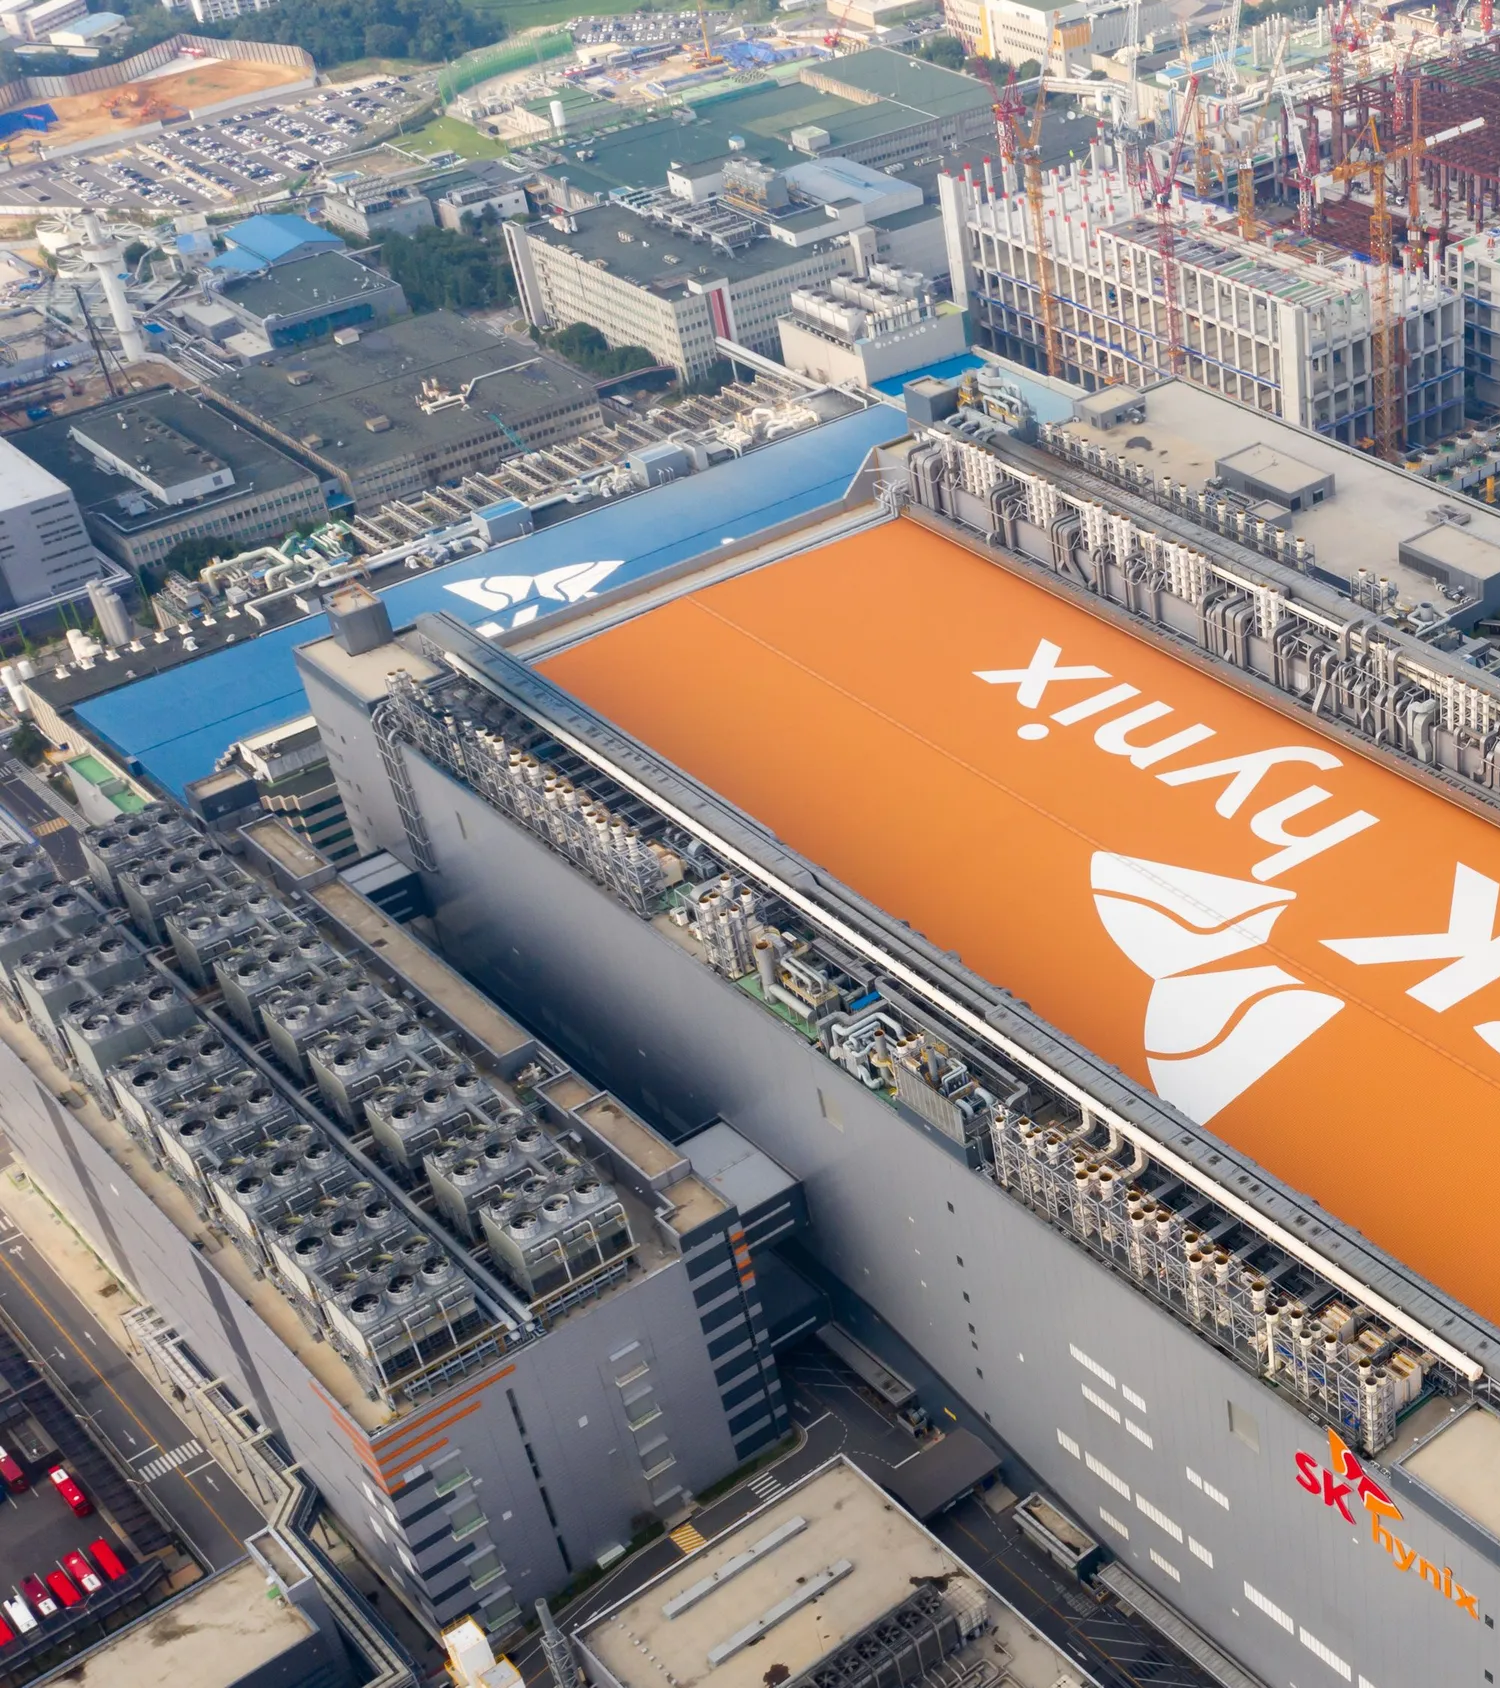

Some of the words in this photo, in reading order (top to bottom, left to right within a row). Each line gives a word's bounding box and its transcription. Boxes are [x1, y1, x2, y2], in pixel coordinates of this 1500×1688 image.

[972, 638, 1380, 881] hynix
[1294, 1450, 1357, 1525] SK
[1372, 1512, 1480, 1621] hynix
